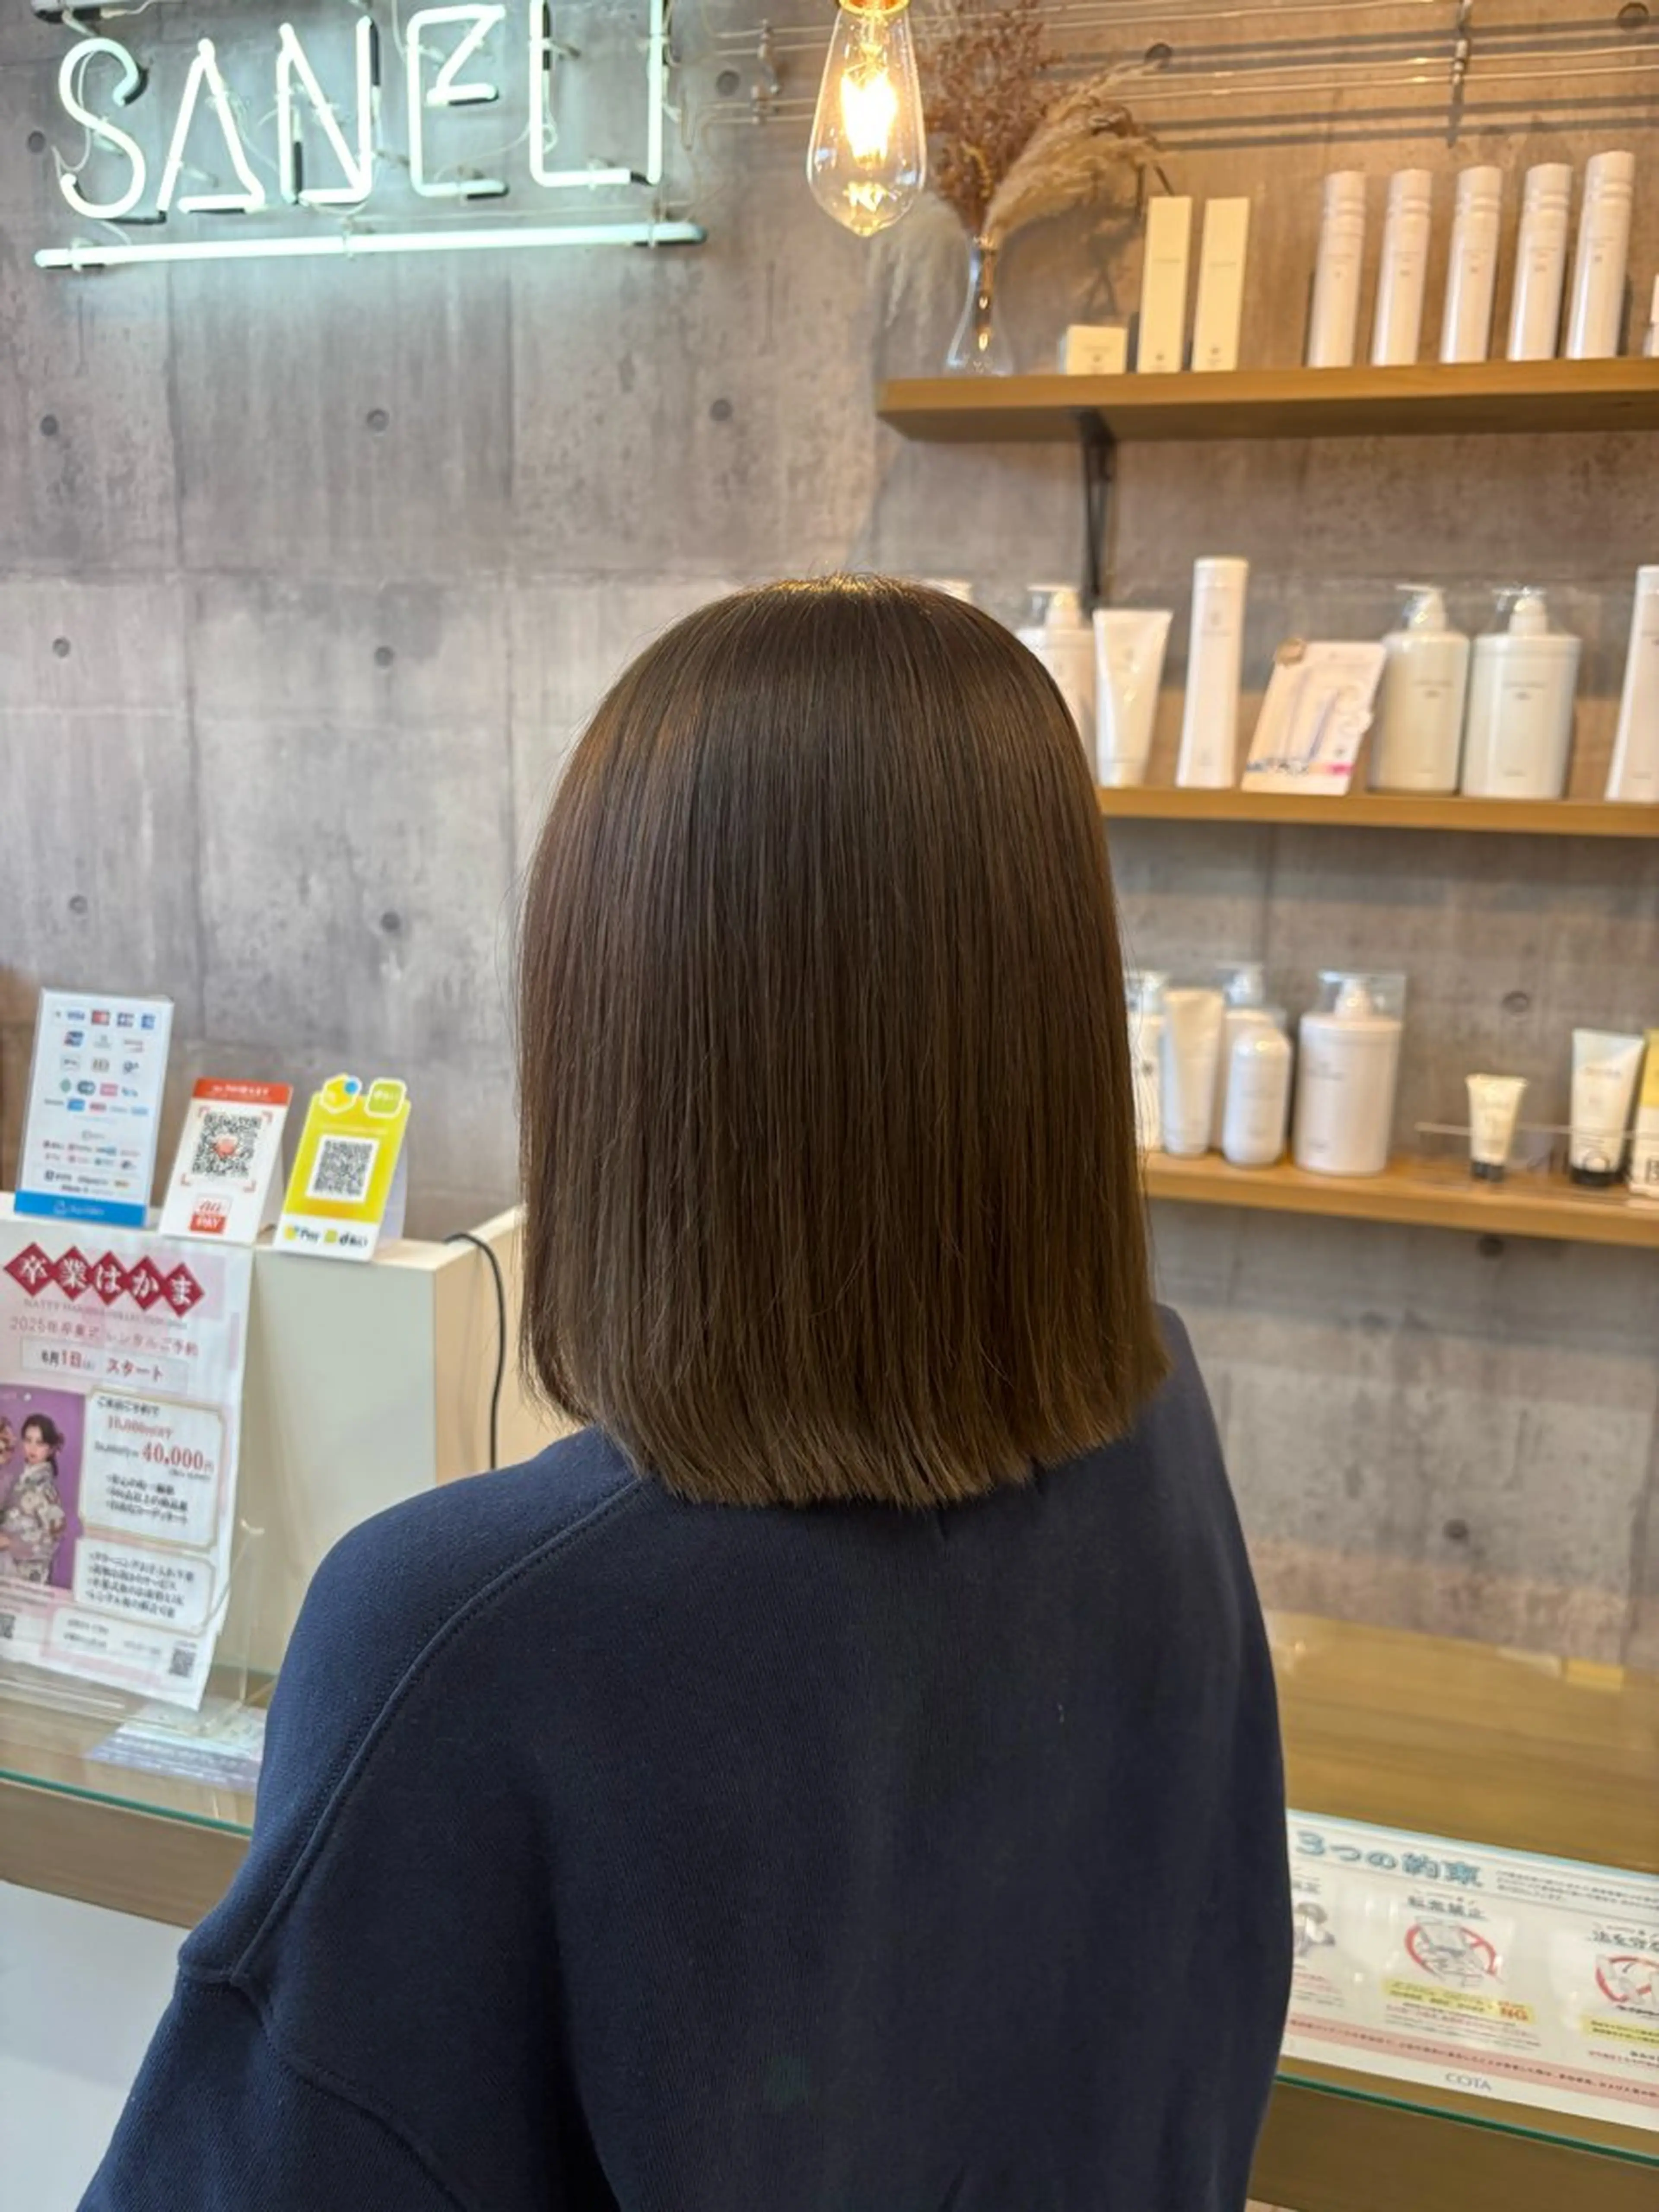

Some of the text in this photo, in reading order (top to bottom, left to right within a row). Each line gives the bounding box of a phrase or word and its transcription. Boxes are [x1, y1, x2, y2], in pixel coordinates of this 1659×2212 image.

[20, 1254, 193, 1306] 卒業はかま
[1296, 1830, 1484, 1888] 3つの約束
[1445, 2072, 1492, 2090] COTA
